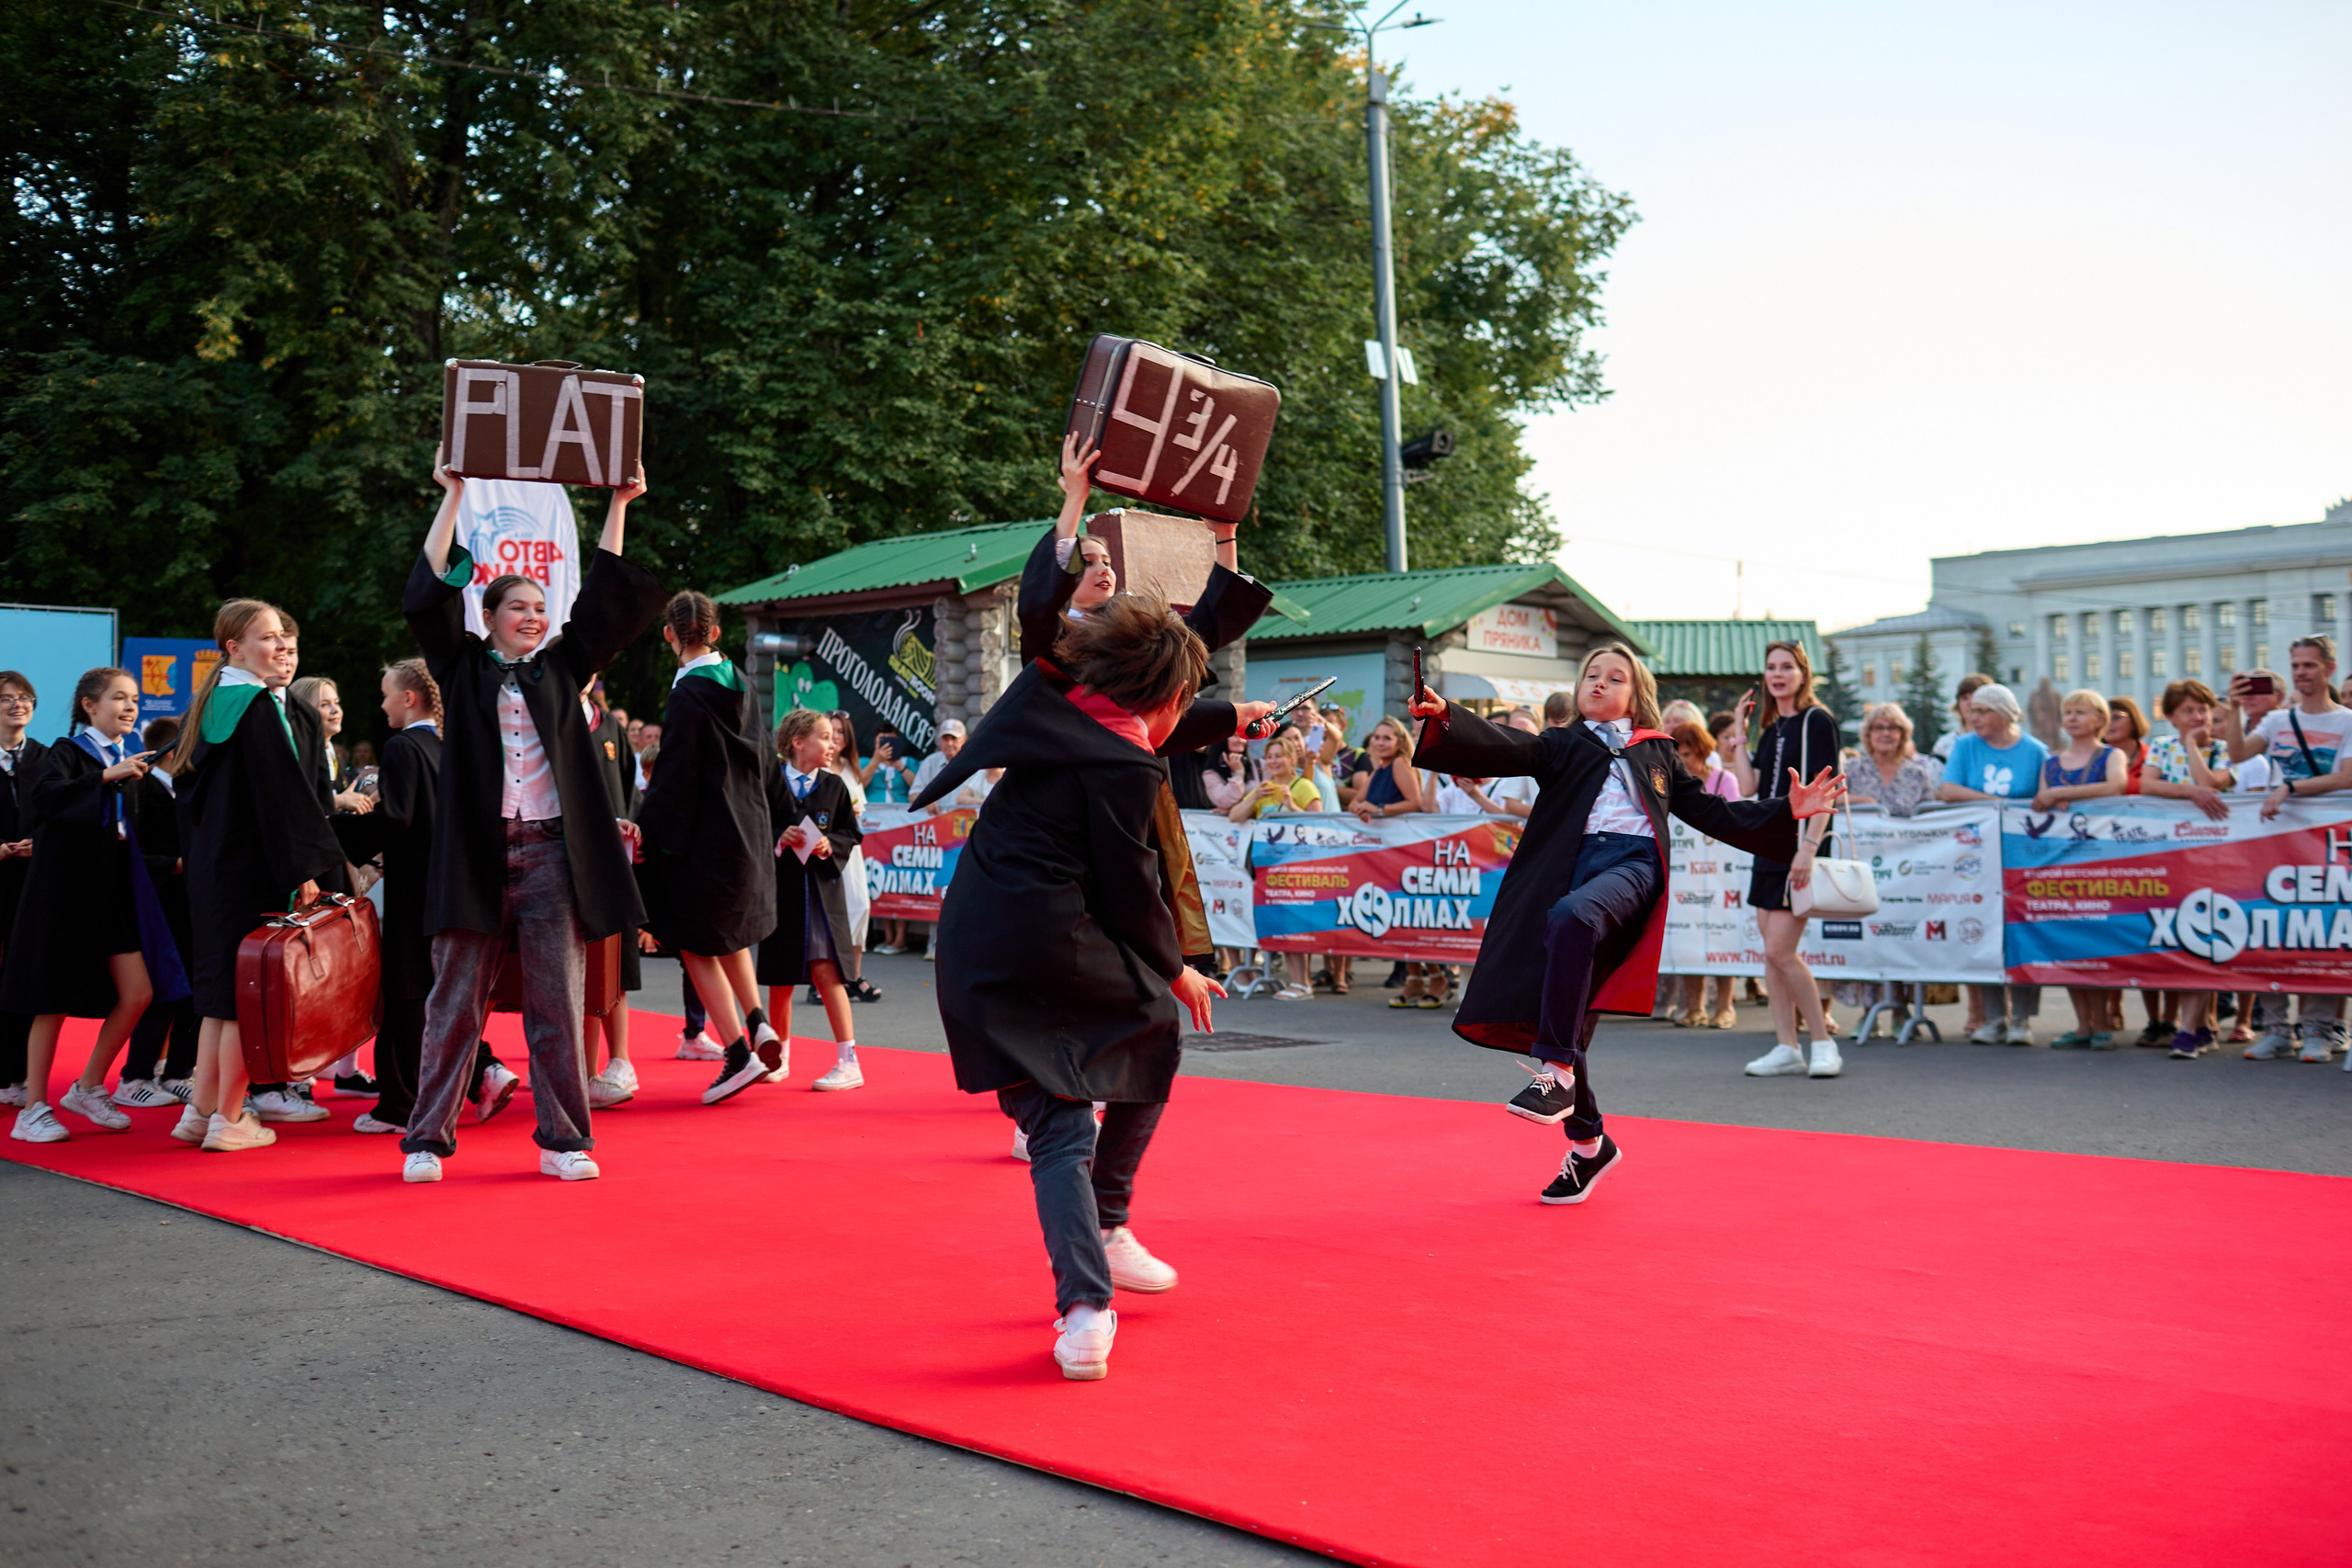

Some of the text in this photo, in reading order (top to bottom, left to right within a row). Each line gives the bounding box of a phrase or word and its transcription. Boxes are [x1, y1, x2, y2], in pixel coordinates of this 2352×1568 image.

[450, 367, 642, 486] PLAT
[1497, 608, 1530, 627] ДОМ
[1484, 629, 1542, 651] ПРЯНИКА
[816, 626, 936, 754] ПРОГОЛОДАЛСЯ?
[913, 824, 936, 846] НА
[892, 844, 944, 870] СЕМИ
[1435, 840, 1471, 866] НА
[1265, 873, 1350, 889] ФЕСТИВАЛЬ
[1401, 866, 1481, 896] СЕМИ
[2026, 879, 2170, 897] ФЕСТИВАЛЬ
[2026, 900, 2110, 911] ТЕАТРА, КИНО
